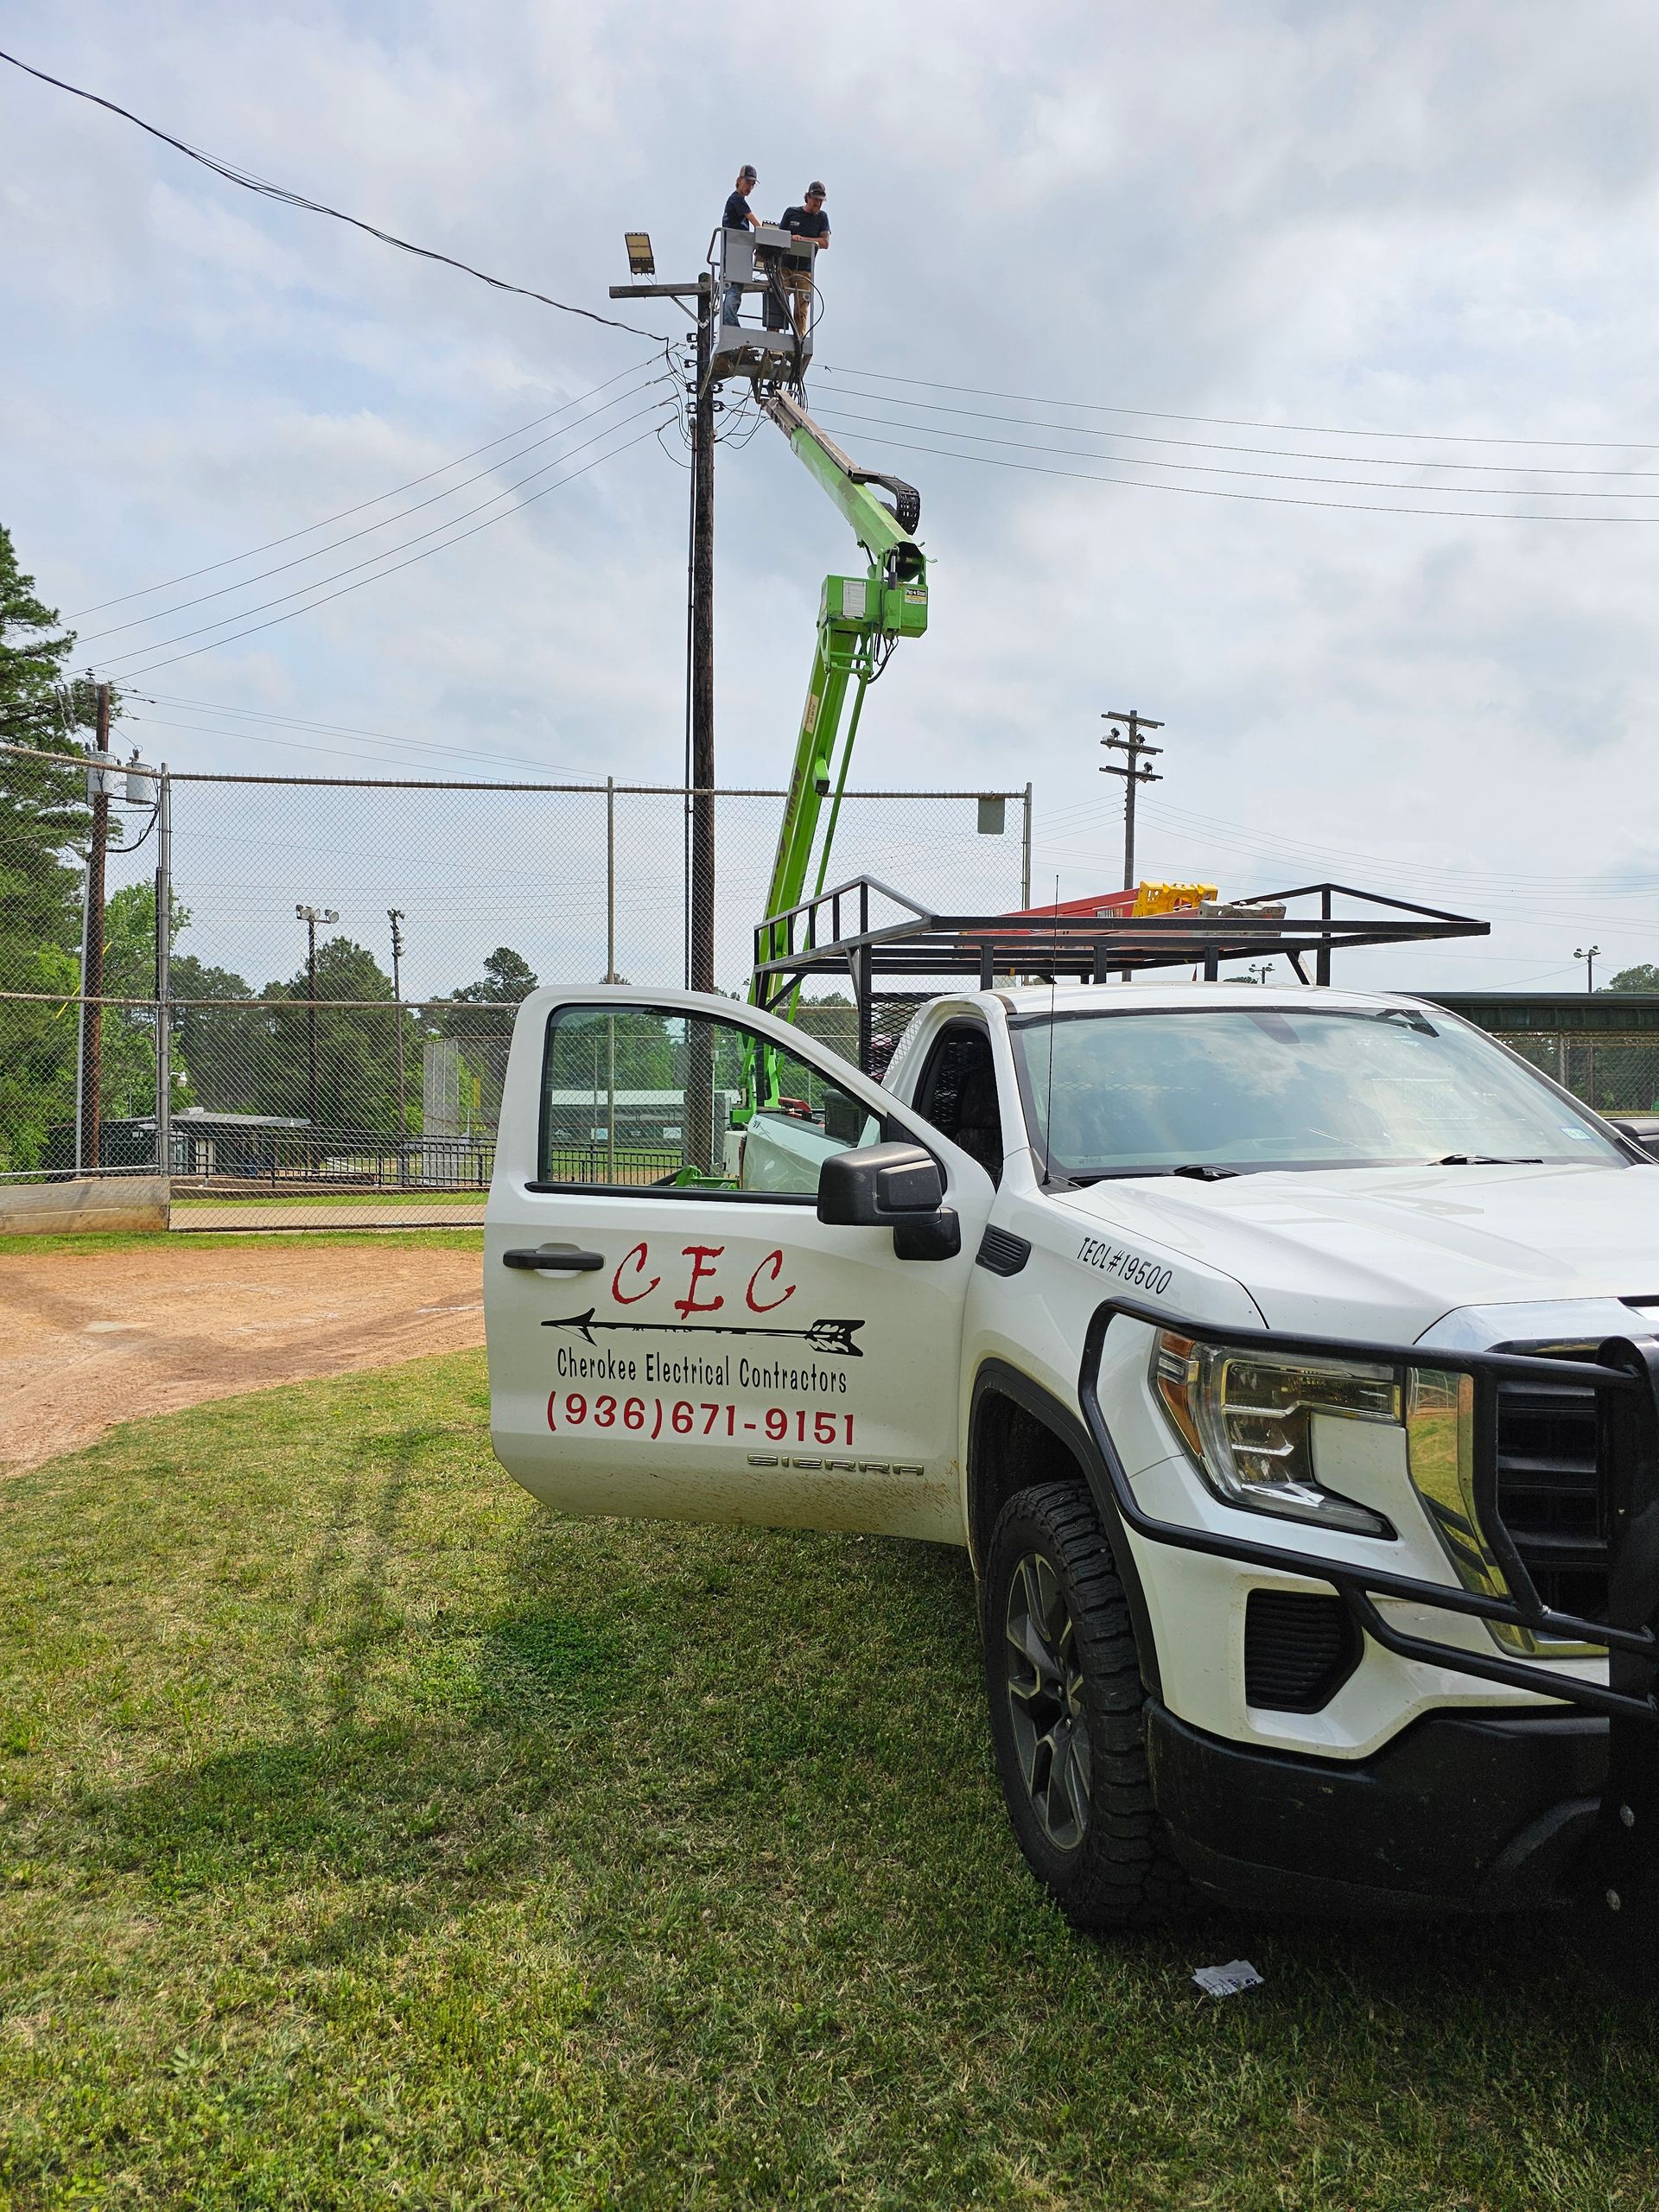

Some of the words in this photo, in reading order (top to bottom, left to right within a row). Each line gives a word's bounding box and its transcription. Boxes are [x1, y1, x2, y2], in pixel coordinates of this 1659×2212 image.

[1077, 1237, 1173, 1294] TECL#19500
[557, 1347, 636, 1381] Cherokee
[646, 1351, 729, 1386] Electrical
[740, 1358, 847, 1393] Contractors
[547, 1390, 854, 1446] (936)671-9151
[747, 1453, 924, 1474] SIERRA
